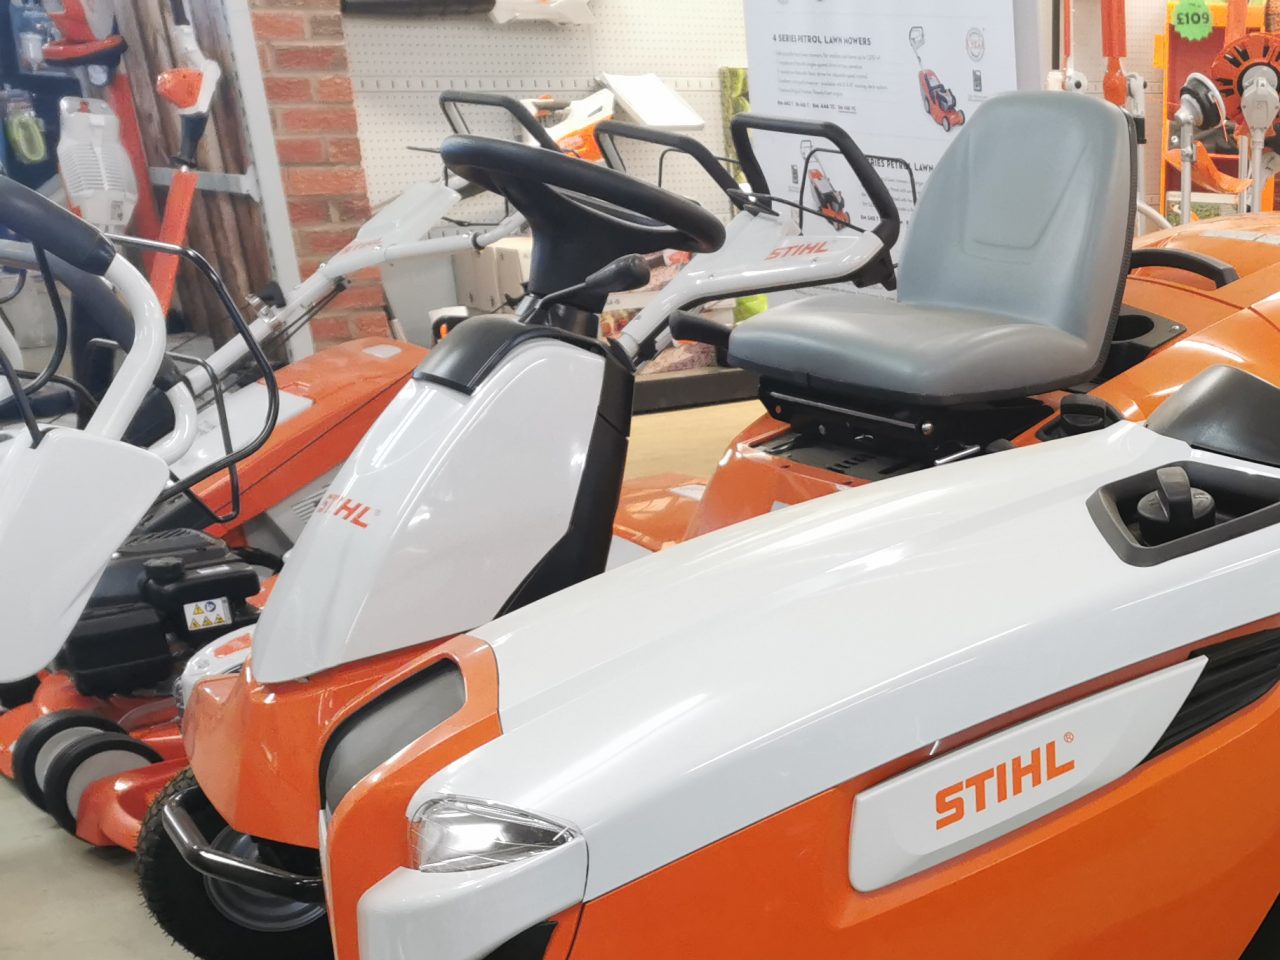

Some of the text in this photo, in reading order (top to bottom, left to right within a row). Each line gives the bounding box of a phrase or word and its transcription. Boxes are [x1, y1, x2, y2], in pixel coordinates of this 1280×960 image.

[1176, 12, 1210, 25] £109
[797, 34, 822, 44] PETROL
[824, 36, 843, 45] LAWN
[843, 36, 871, 46] MOWERS
[764, 241, 828, 260] STIHL
[935, 740, 1075, 830] STIHL
